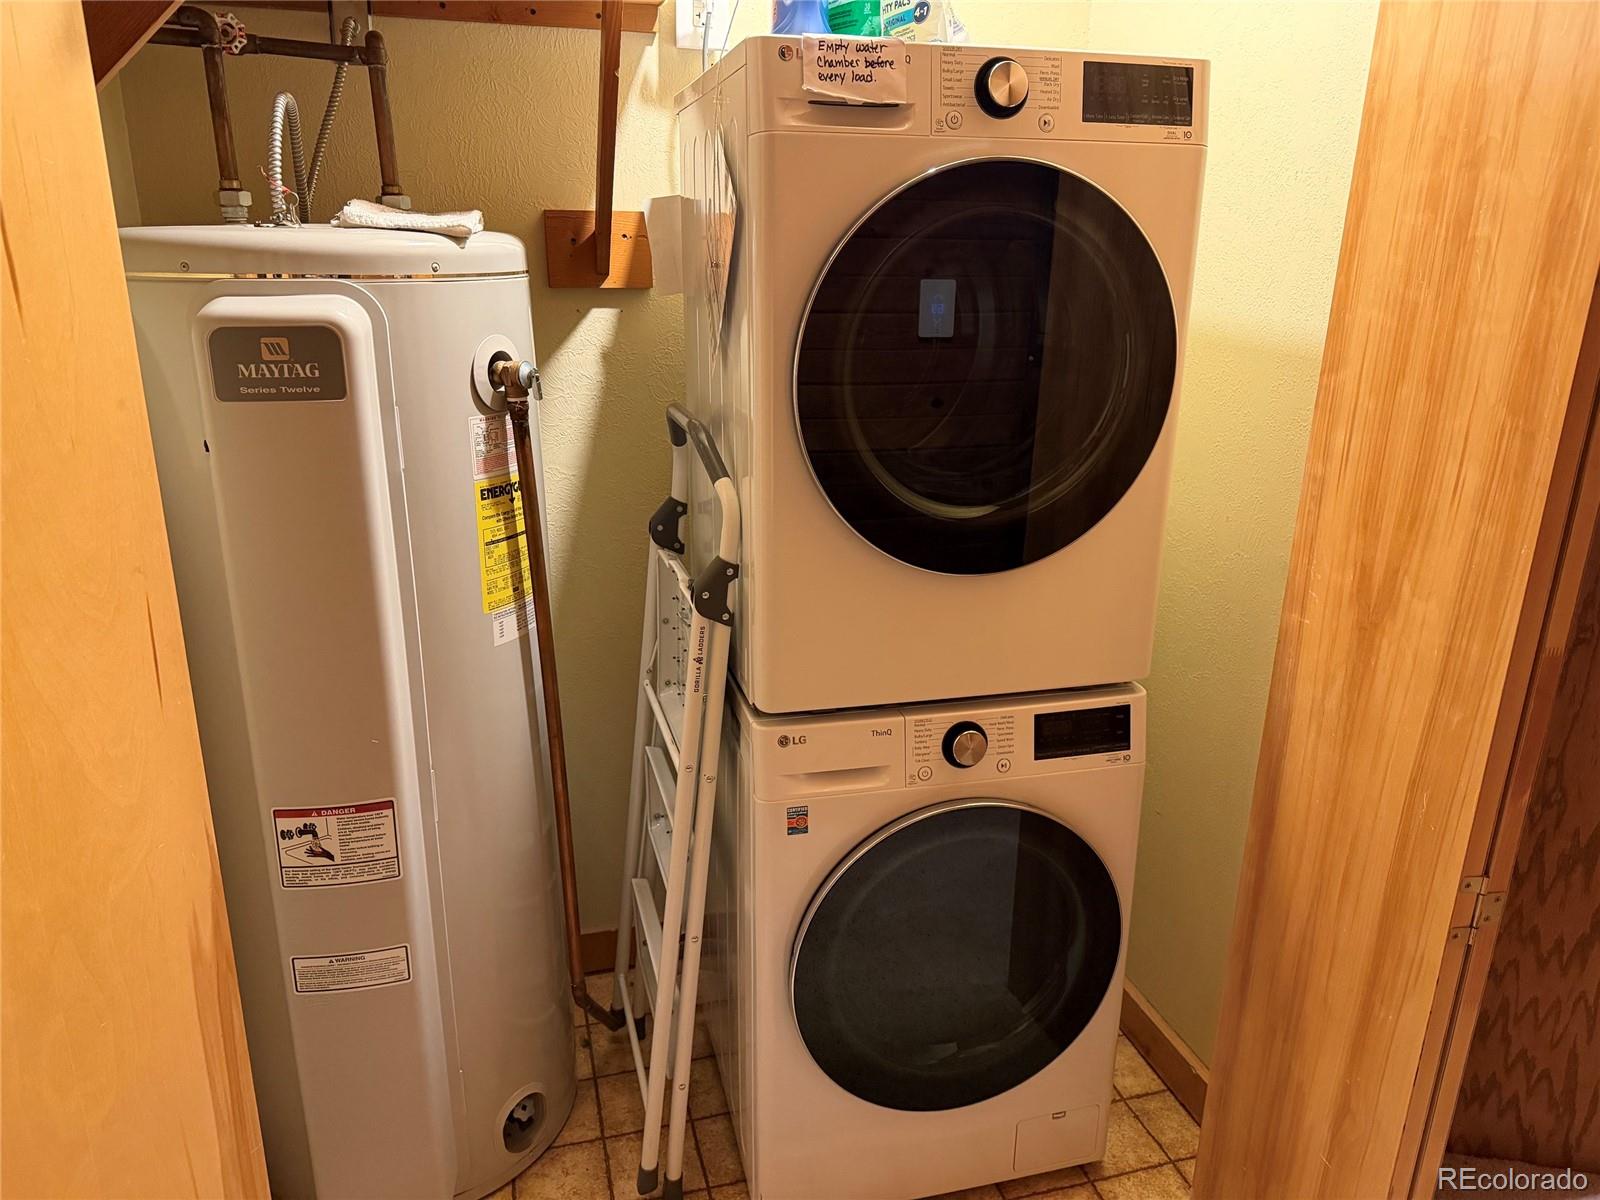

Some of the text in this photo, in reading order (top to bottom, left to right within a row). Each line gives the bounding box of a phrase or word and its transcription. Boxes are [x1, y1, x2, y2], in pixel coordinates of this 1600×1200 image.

[914, 6, 928, 18] 4-1
[818, 39, 888, 55] Empty water
[817, 55, 896, 69] Chamber before
[818, 70, 877, 85] every load.
[237, 362, 320, 378] MAYTAG
[240, 385, 321, 394] Series Twelve
[480, 480, 523, 502] ENERGYG
[694, 626, 706, 693] GORILLA LADDERS
[871, 728, 892, 737] ThinQ
[792, 735, 807, 745] LG
[321, 807, 356, 816] DANGER
[334, 955, 366, 963] WARNING
